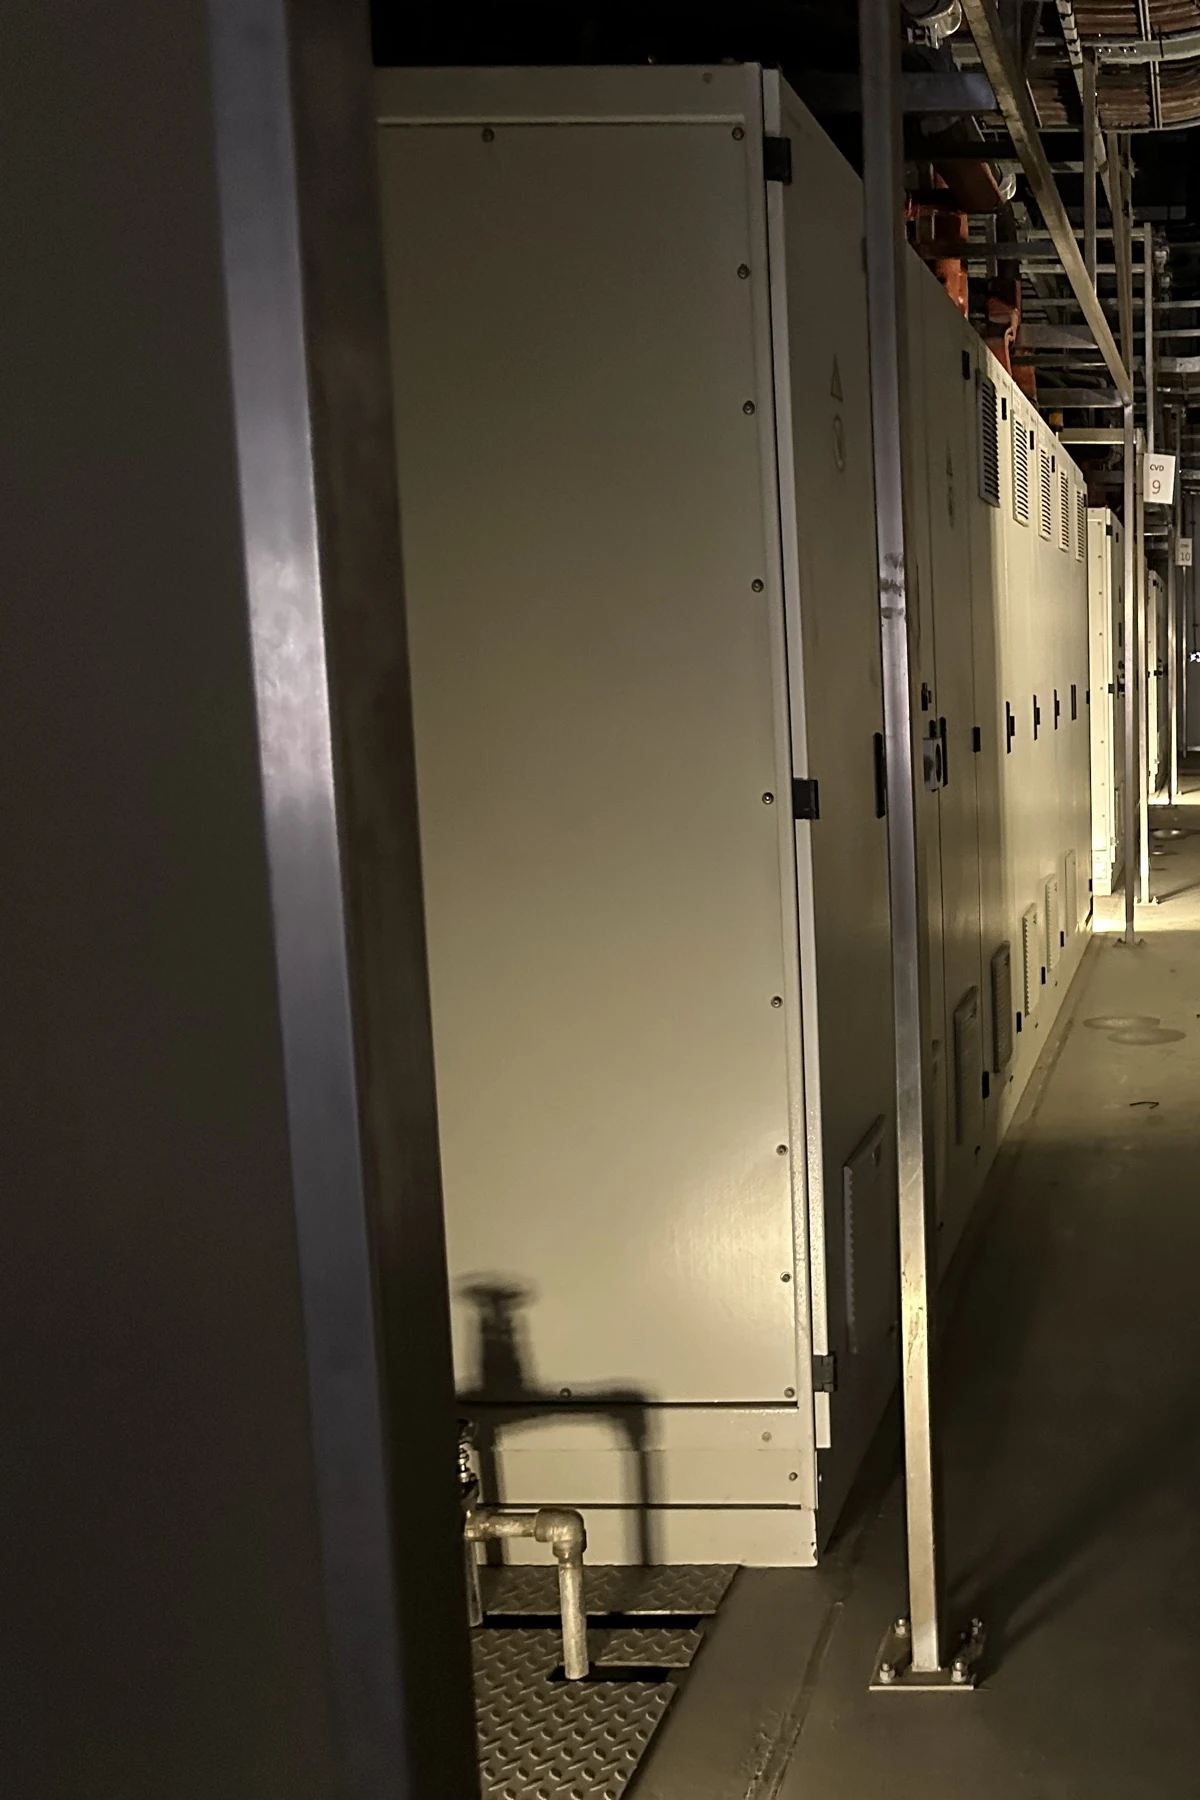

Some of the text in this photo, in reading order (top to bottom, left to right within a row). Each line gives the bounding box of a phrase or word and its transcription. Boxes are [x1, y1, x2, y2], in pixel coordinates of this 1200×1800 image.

[1149, 464, 1164, 472] CVD
[1152, 479, 1161, 495] 9
[1180, 552, 1191, 562] 10
